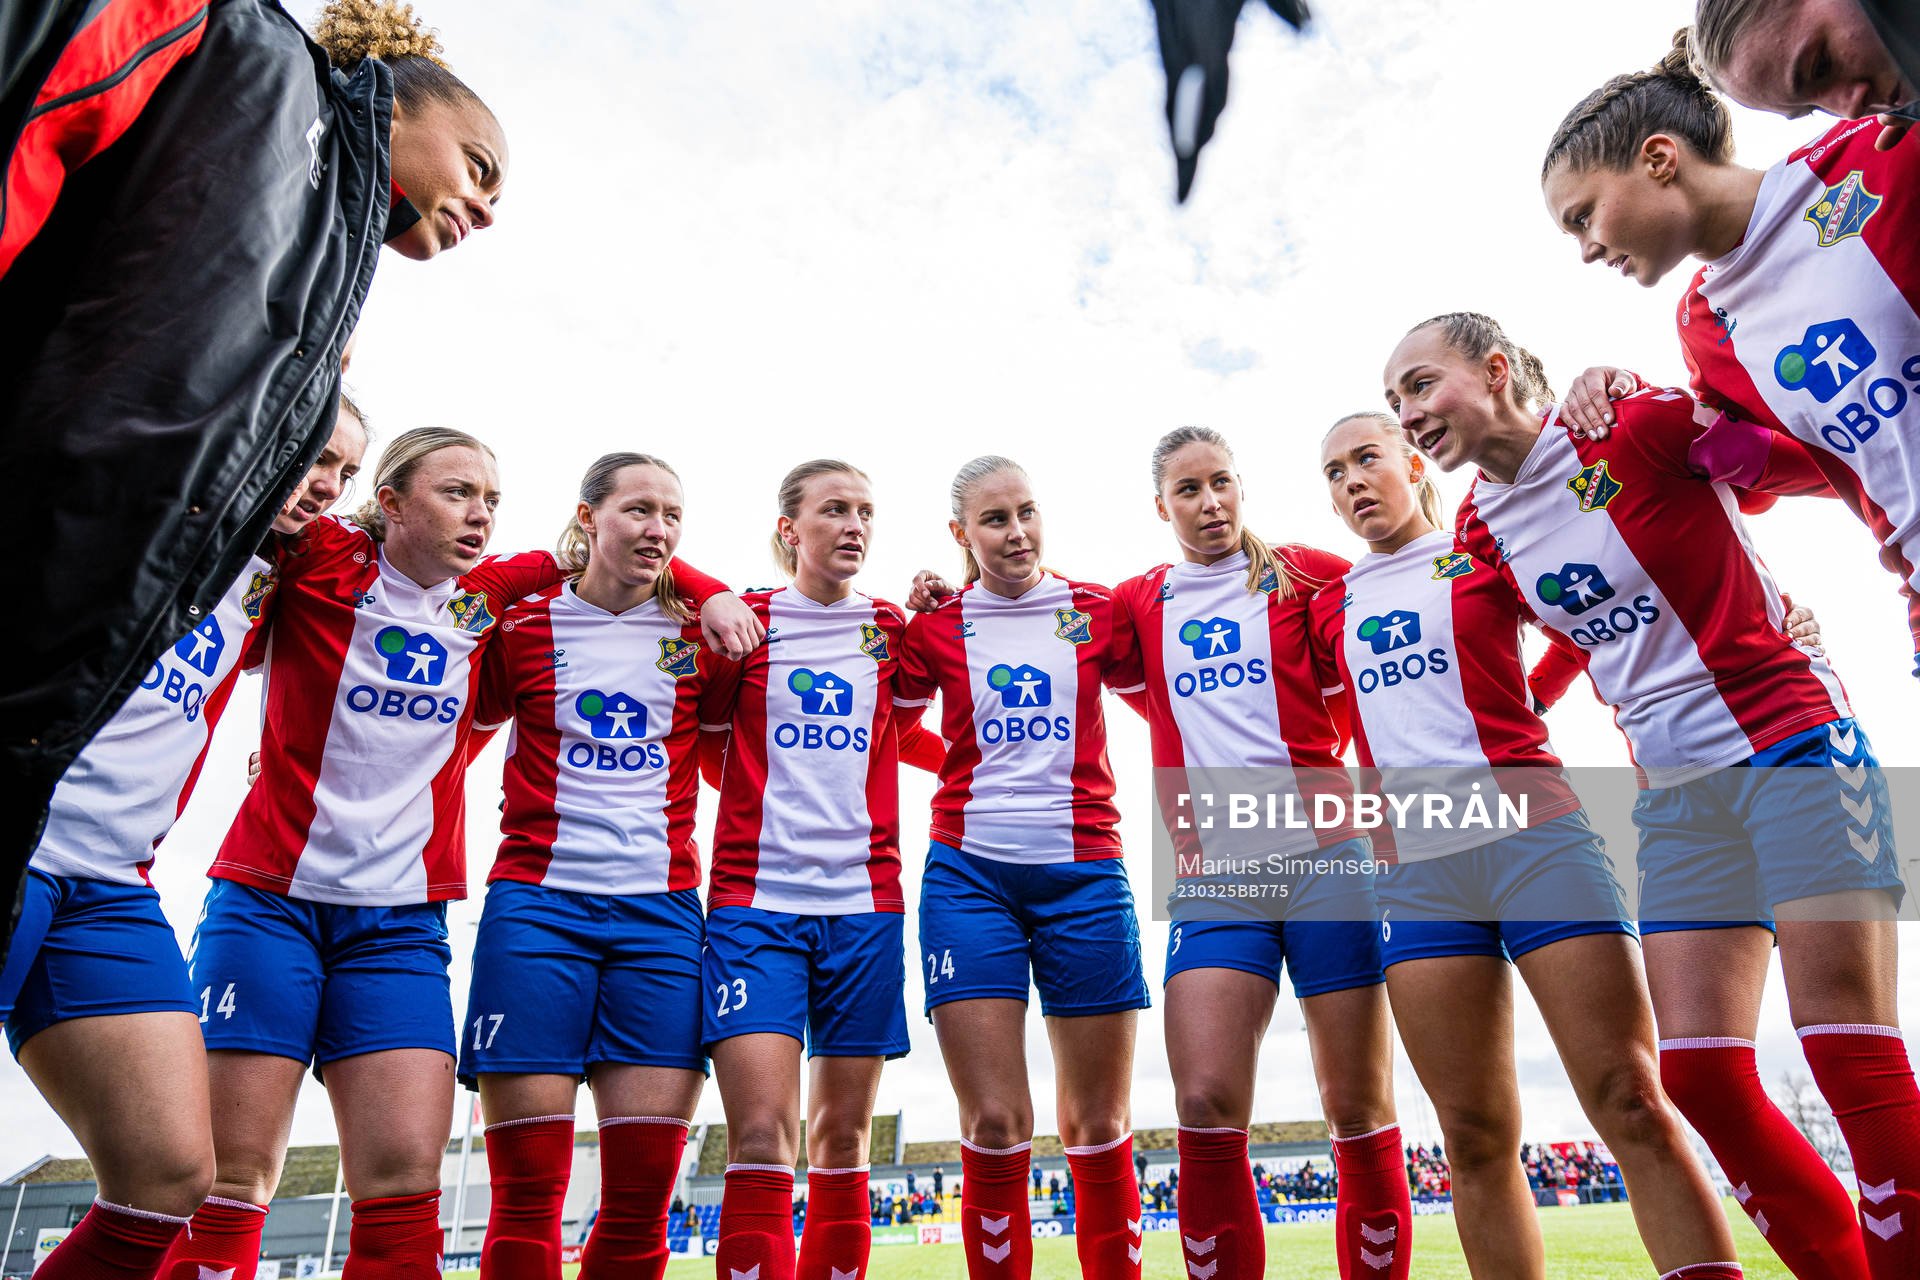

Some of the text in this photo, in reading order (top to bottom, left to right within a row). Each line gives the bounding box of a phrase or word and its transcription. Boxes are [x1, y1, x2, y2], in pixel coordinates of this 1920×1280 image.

[1831, 192, 1849, 226] LYN
[1821, 354, 1920, 454] OBOS
[1588, 474, 1600, 497] LYN
[464, 602, 479, 622] LYN
[1571, 594, 1660, 646] OBOS
[670, 650, 689, 663] LYN
[1359, 648, 1449, 694] OBOS
[1175, 658, 1267, 697] OBOS
[346, 684, 460, 724] OBOS
[774, 722, 868, 752] OBOS
[982, 716, 1070, 744] OBOS
[567, 742, 664, 771] OBOS
[1382, 908, 1391, 942] 6
[927, 949, 955, 985] 24
[198, 982, 236, 1023] 14
[716, 978, 748, 1018] 23
[472, 1013, 505, 1051] 17
